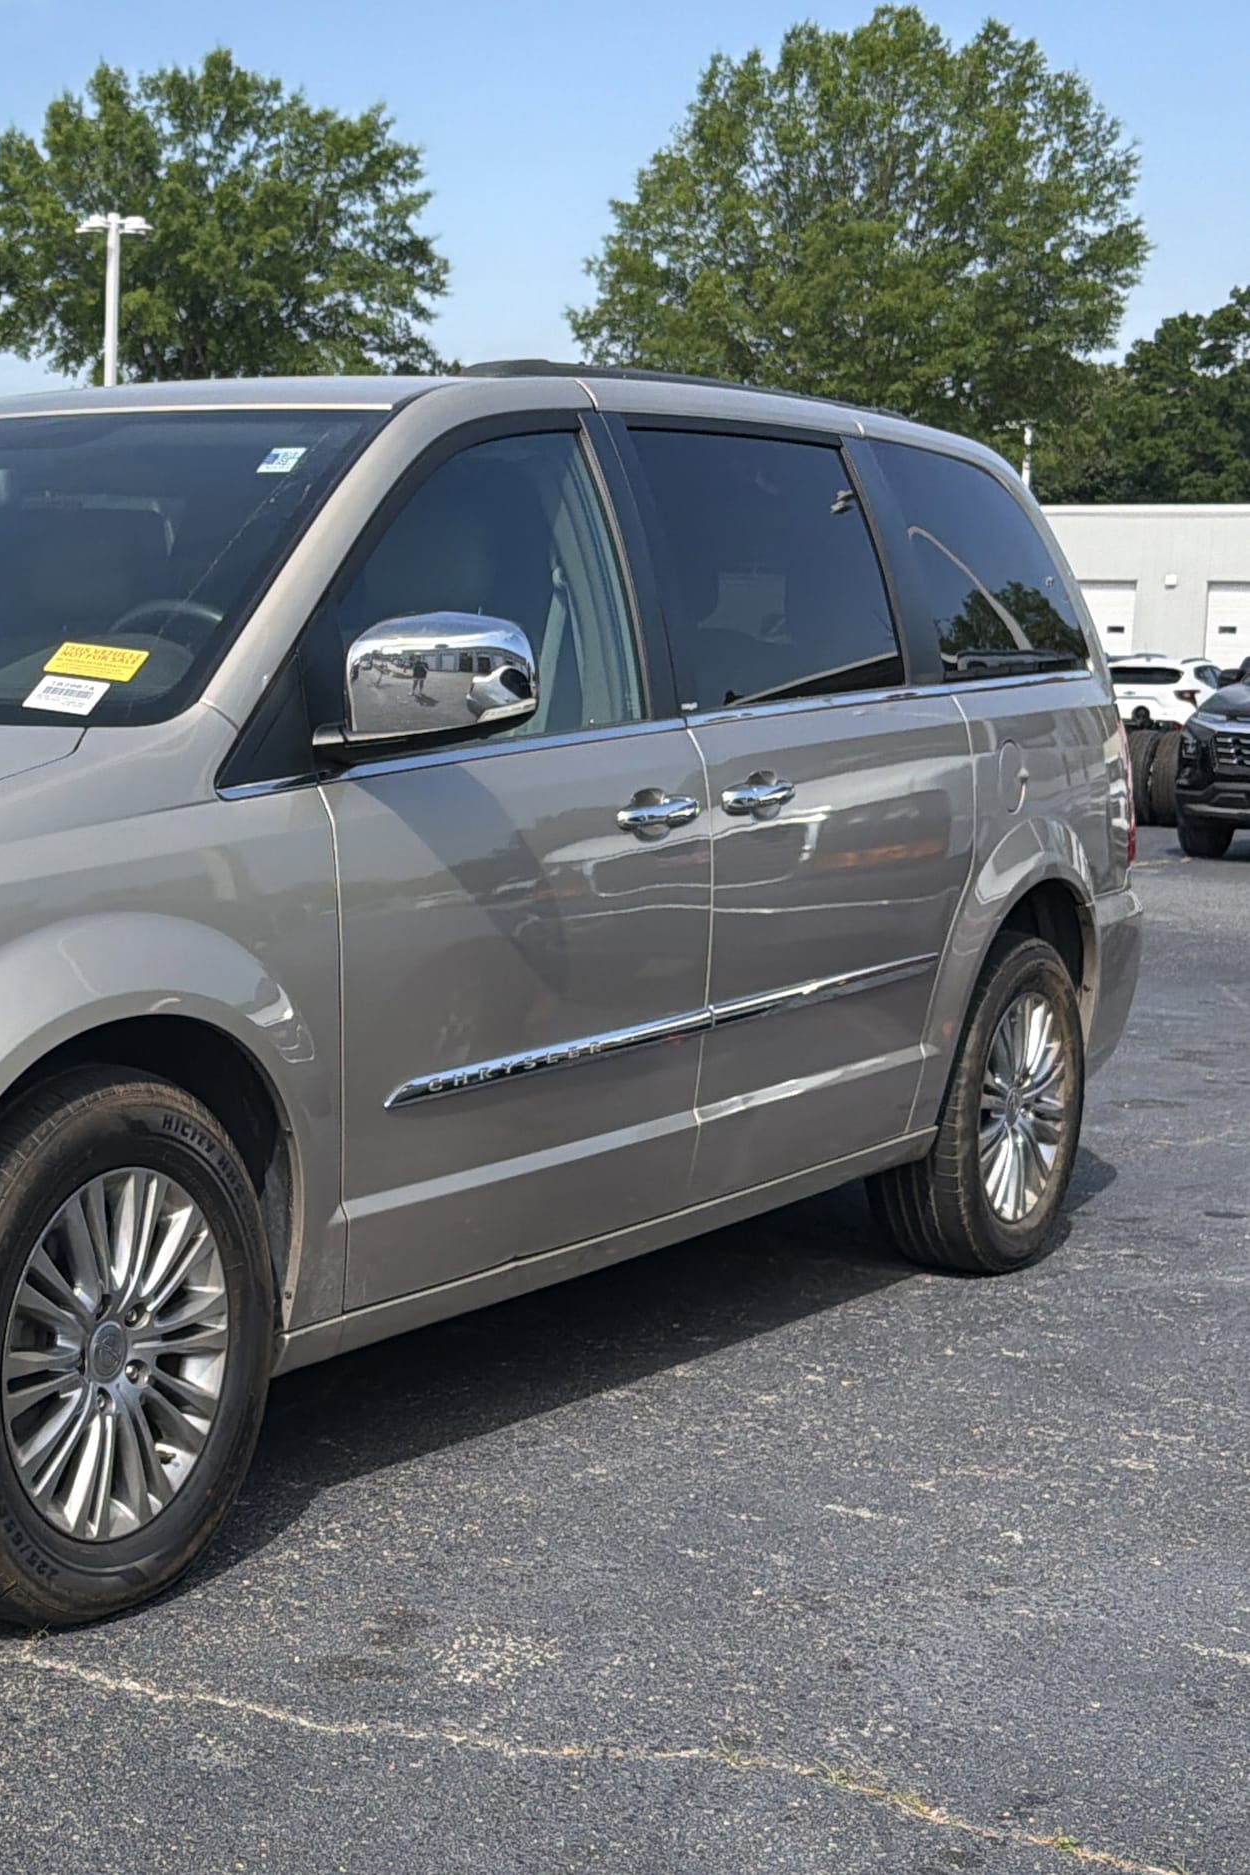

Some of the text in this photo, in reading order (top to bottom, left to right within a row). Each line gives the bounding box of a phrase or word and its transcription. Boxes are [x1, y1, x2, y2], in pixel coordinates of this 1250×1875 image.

[65, 645, 144, 660] THIS VEHICLE
[85, 653, 109, 662] FOR
[110, 656, 138, 665] SALE
[428, 1041, 601, 1093] CHRYSLER
[162, 1114, 216, 1153] HICITY
